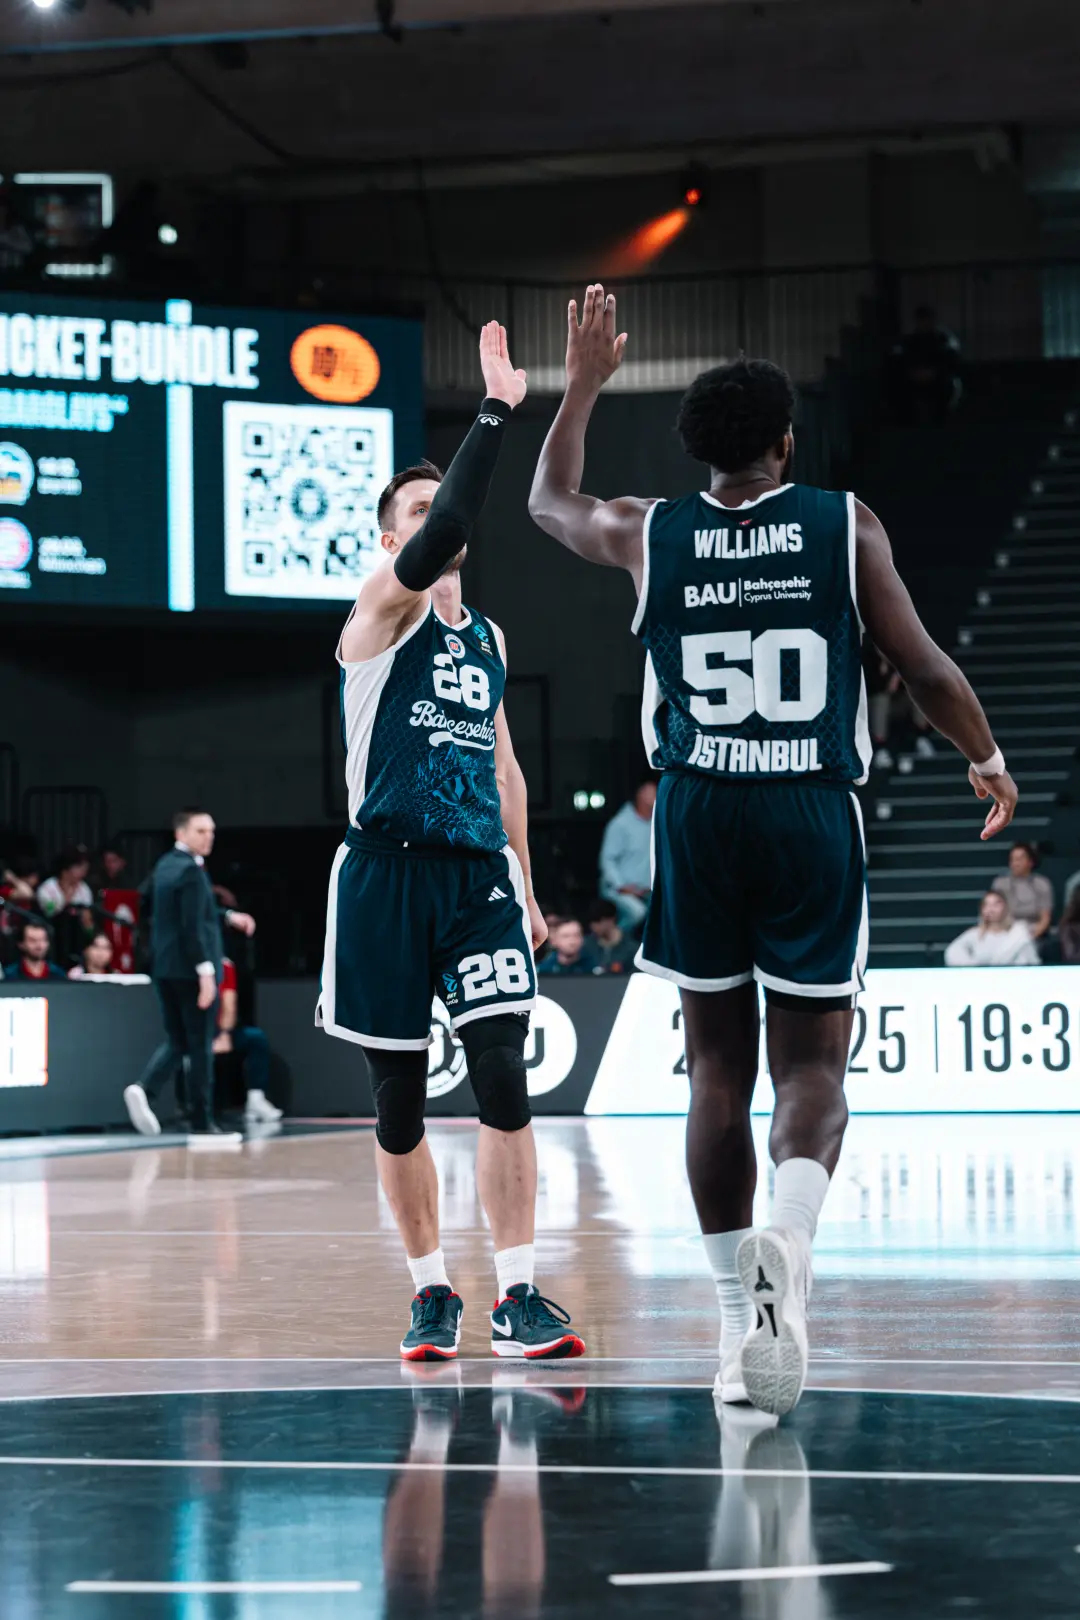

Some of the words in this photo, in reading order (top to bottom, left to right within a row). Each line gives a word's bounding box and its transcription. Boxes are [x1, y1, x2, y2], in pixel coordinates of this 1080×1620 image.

[694, 523, 803, 559] WILLIAMS
[684, 582, 737, 608] BAU
[743, 576, 811, 591] Bahçeşehir
[743, 592, 772, 603] Cyprus
[773, 590, 812, 601] University
[432, 653, 490, 711] 28
[681, 628, 828, 725] 50
[687, 728, 822, 773] İSTANBUL
[457, 948, 530, 1002] 28
